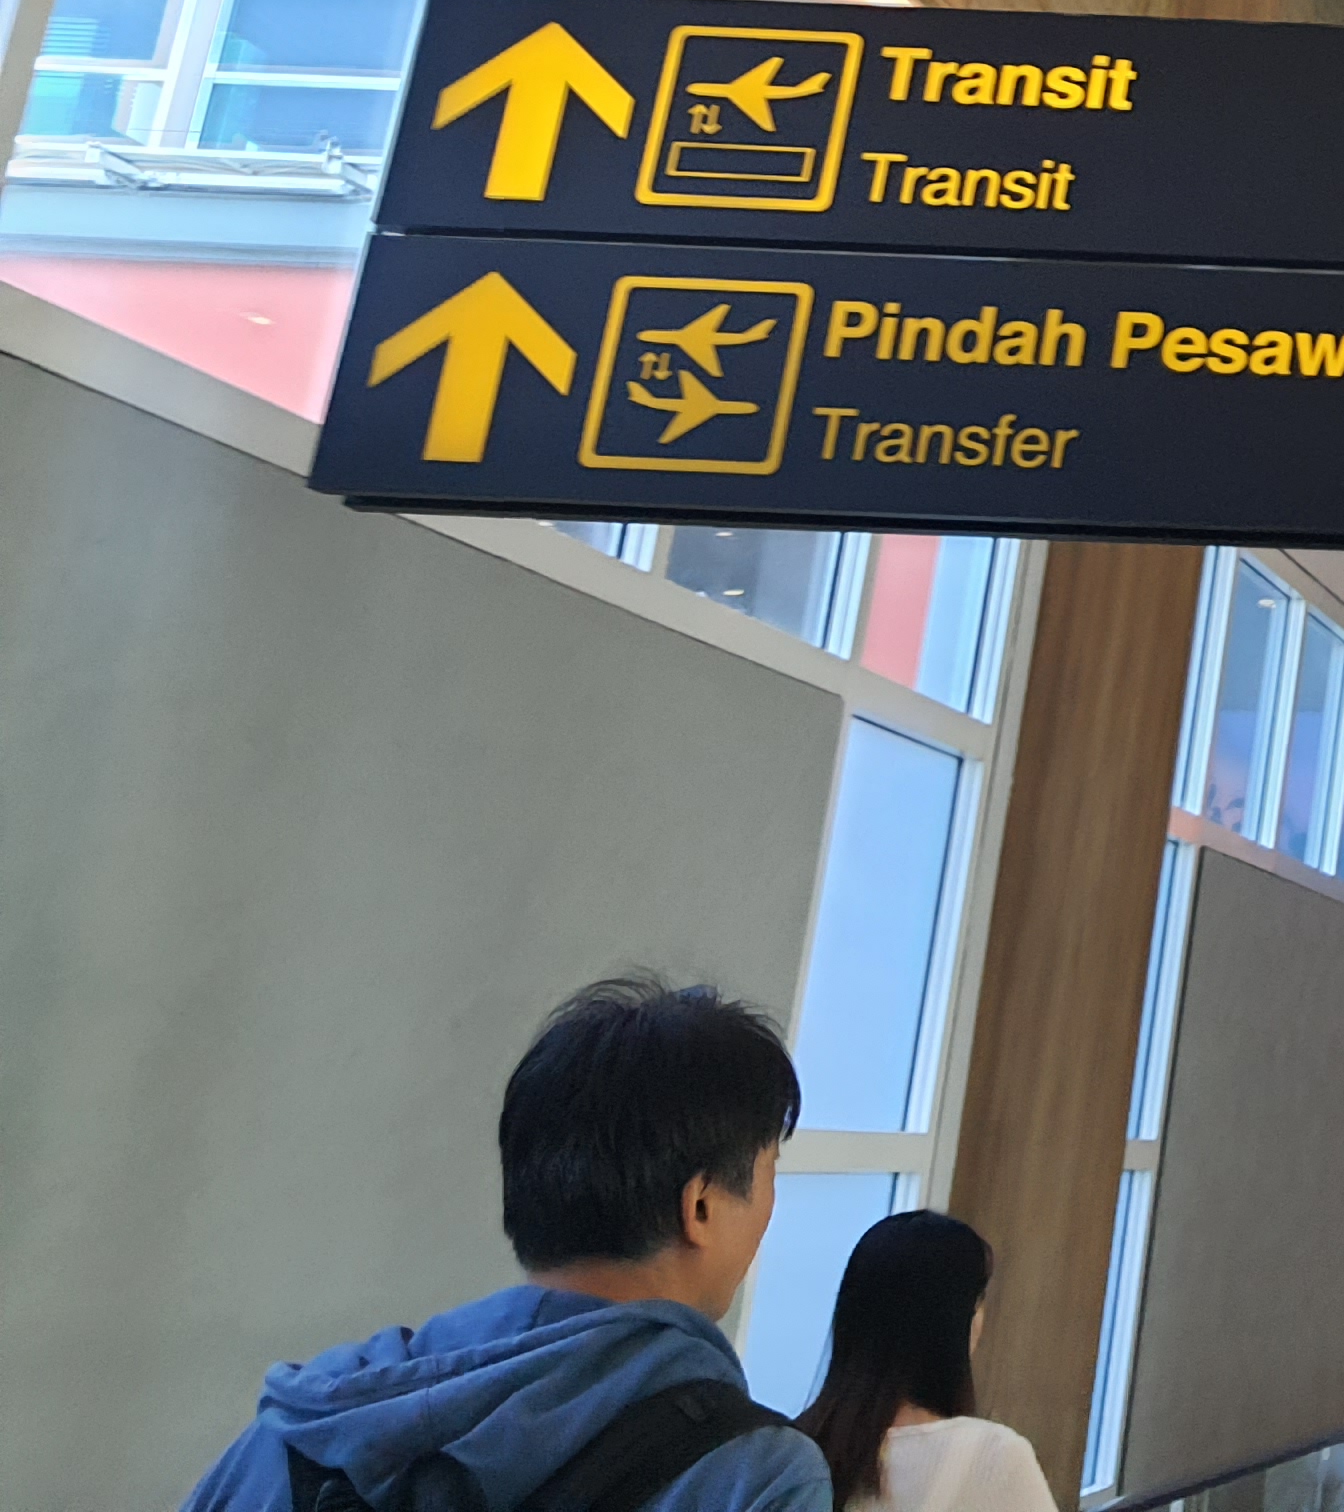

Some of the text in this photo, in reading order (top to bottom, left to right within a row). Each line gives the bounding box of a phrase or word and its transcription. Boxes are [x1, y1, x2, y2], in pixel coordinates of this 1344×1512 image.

[881, 46, 1138, 111] Transit
[861, 152, 1076, 211] Transit
[824, 300, 1086, 367] Pindah
[813, 407, 1079, 469] Transfer
